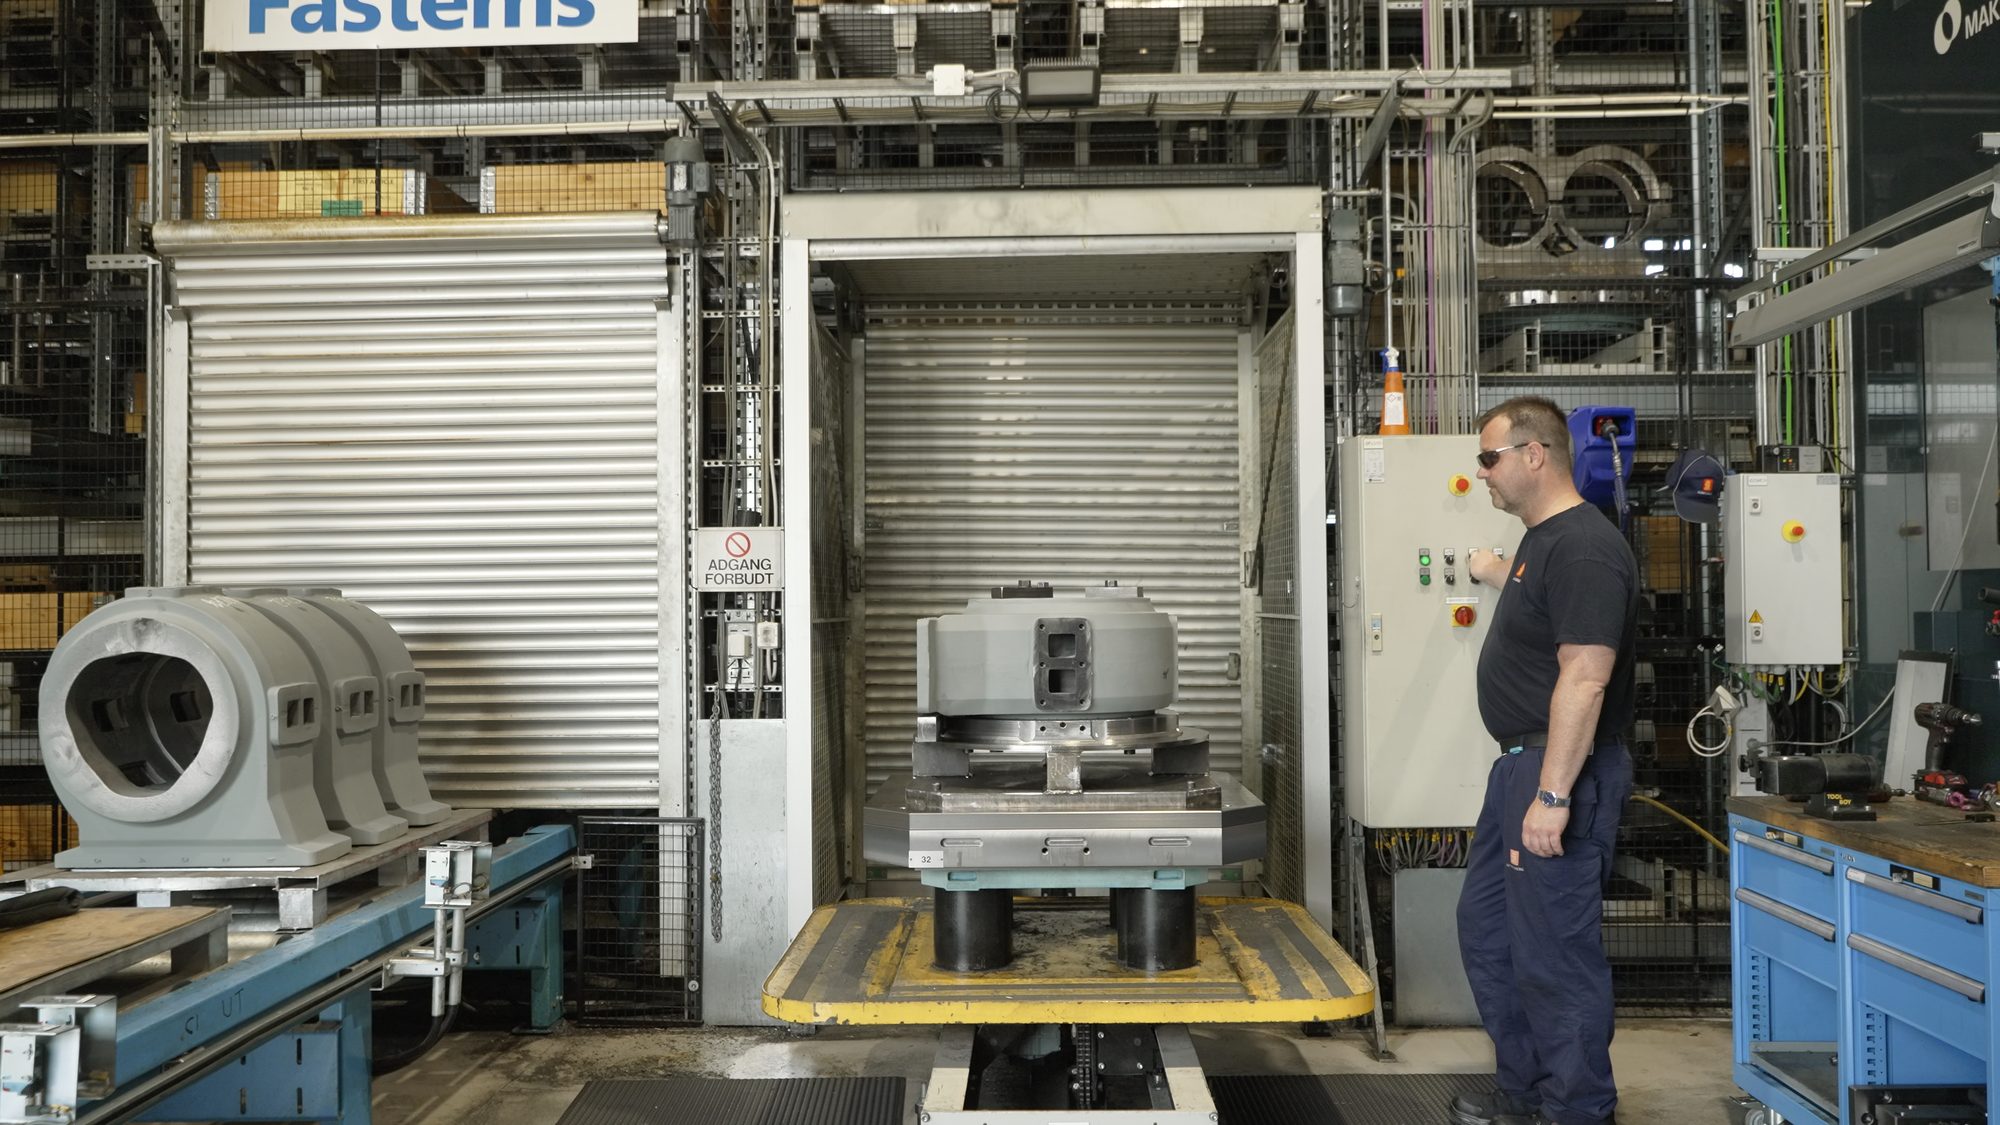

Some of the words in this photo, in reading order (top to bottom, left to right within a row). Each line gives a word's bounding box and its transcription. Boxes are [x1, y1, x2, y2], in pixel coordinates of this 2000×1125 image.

[248, 0, 596, 35] Fastems
[707, 558, 772, 571] ADGANG
[705, 572, 774, 585] FORBUDT
